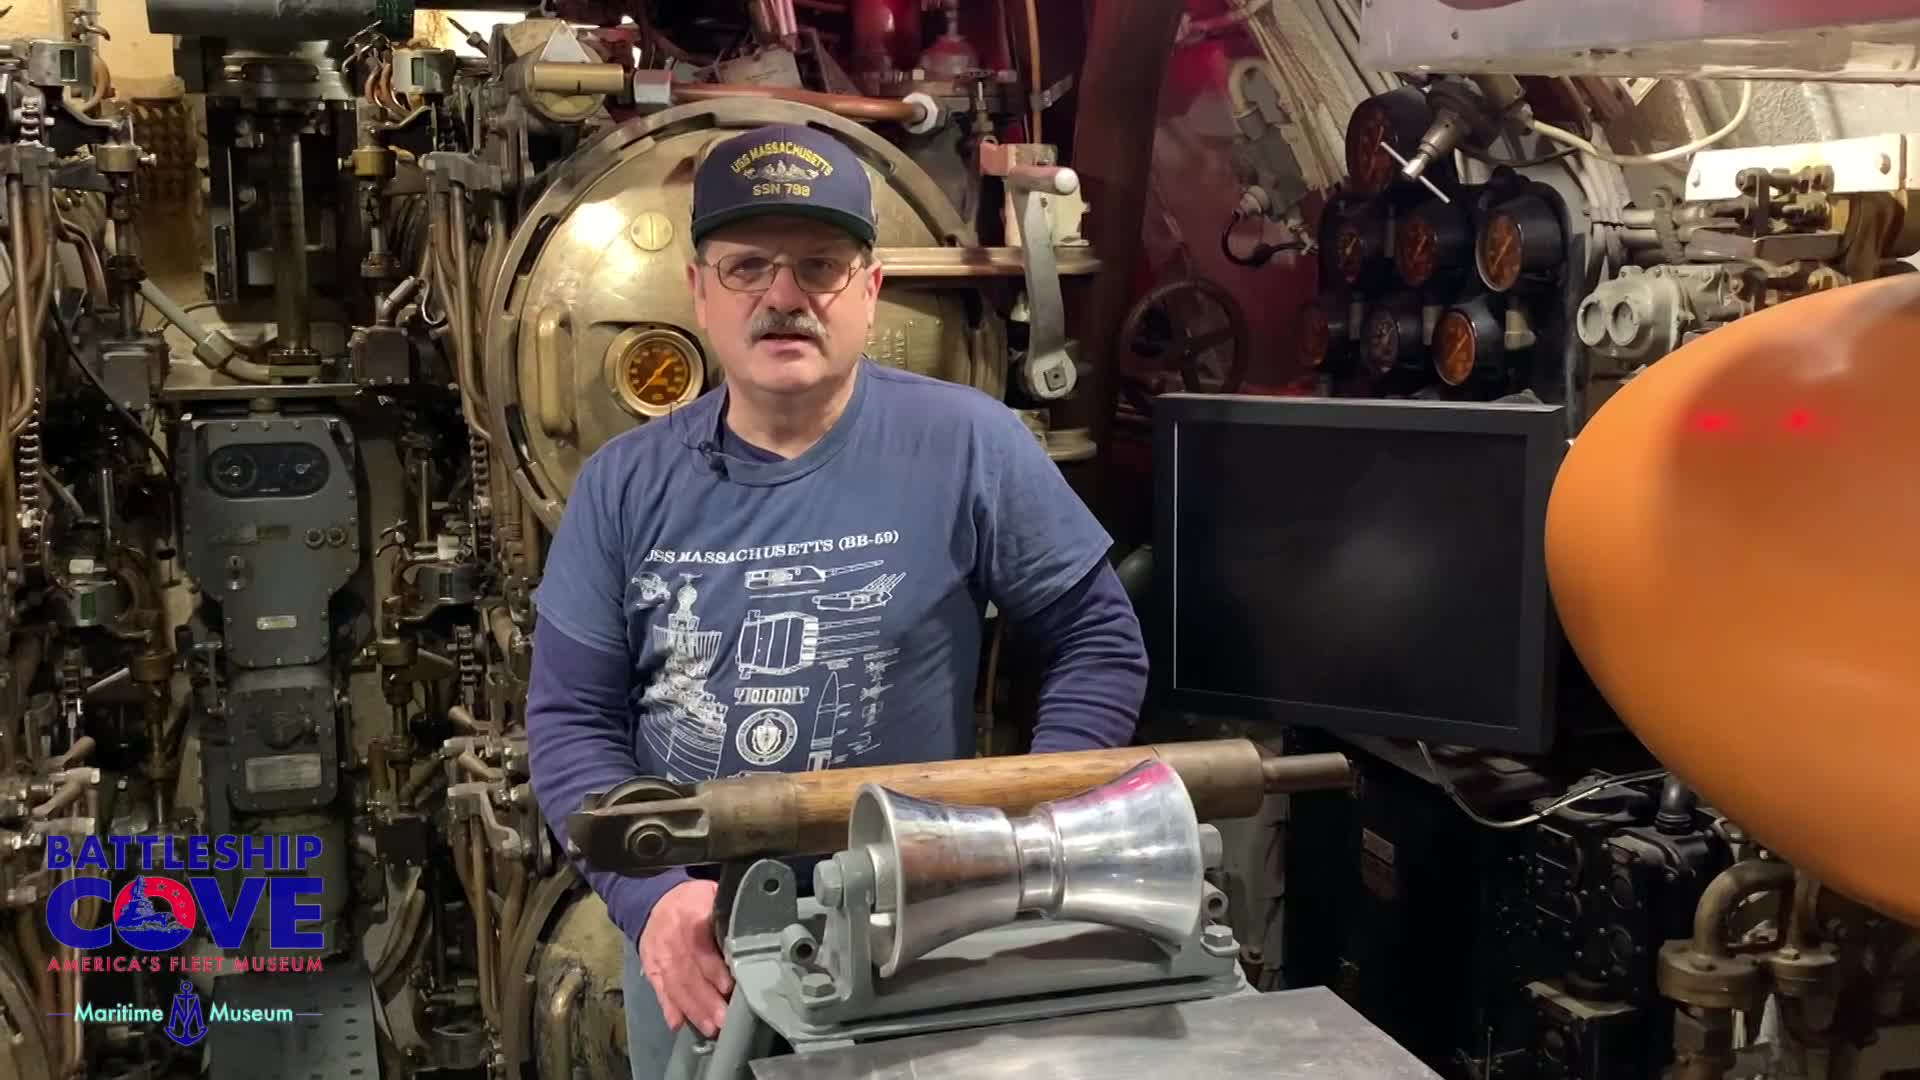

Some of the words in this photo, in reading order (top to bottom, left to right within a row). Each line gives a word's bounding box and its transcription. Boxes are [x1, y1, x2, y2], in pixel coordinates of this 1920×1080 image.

[730, 153, 752, 174] USS
[749, 141, 834, 177] MASSACHUSETTS
[752, 183, 780, 196] SSN
[784, 183, 811, 197] 798
[677, 539, 834, 565] MASSACHUSETTS
[838, 529, 899, 551] (BB-59)
